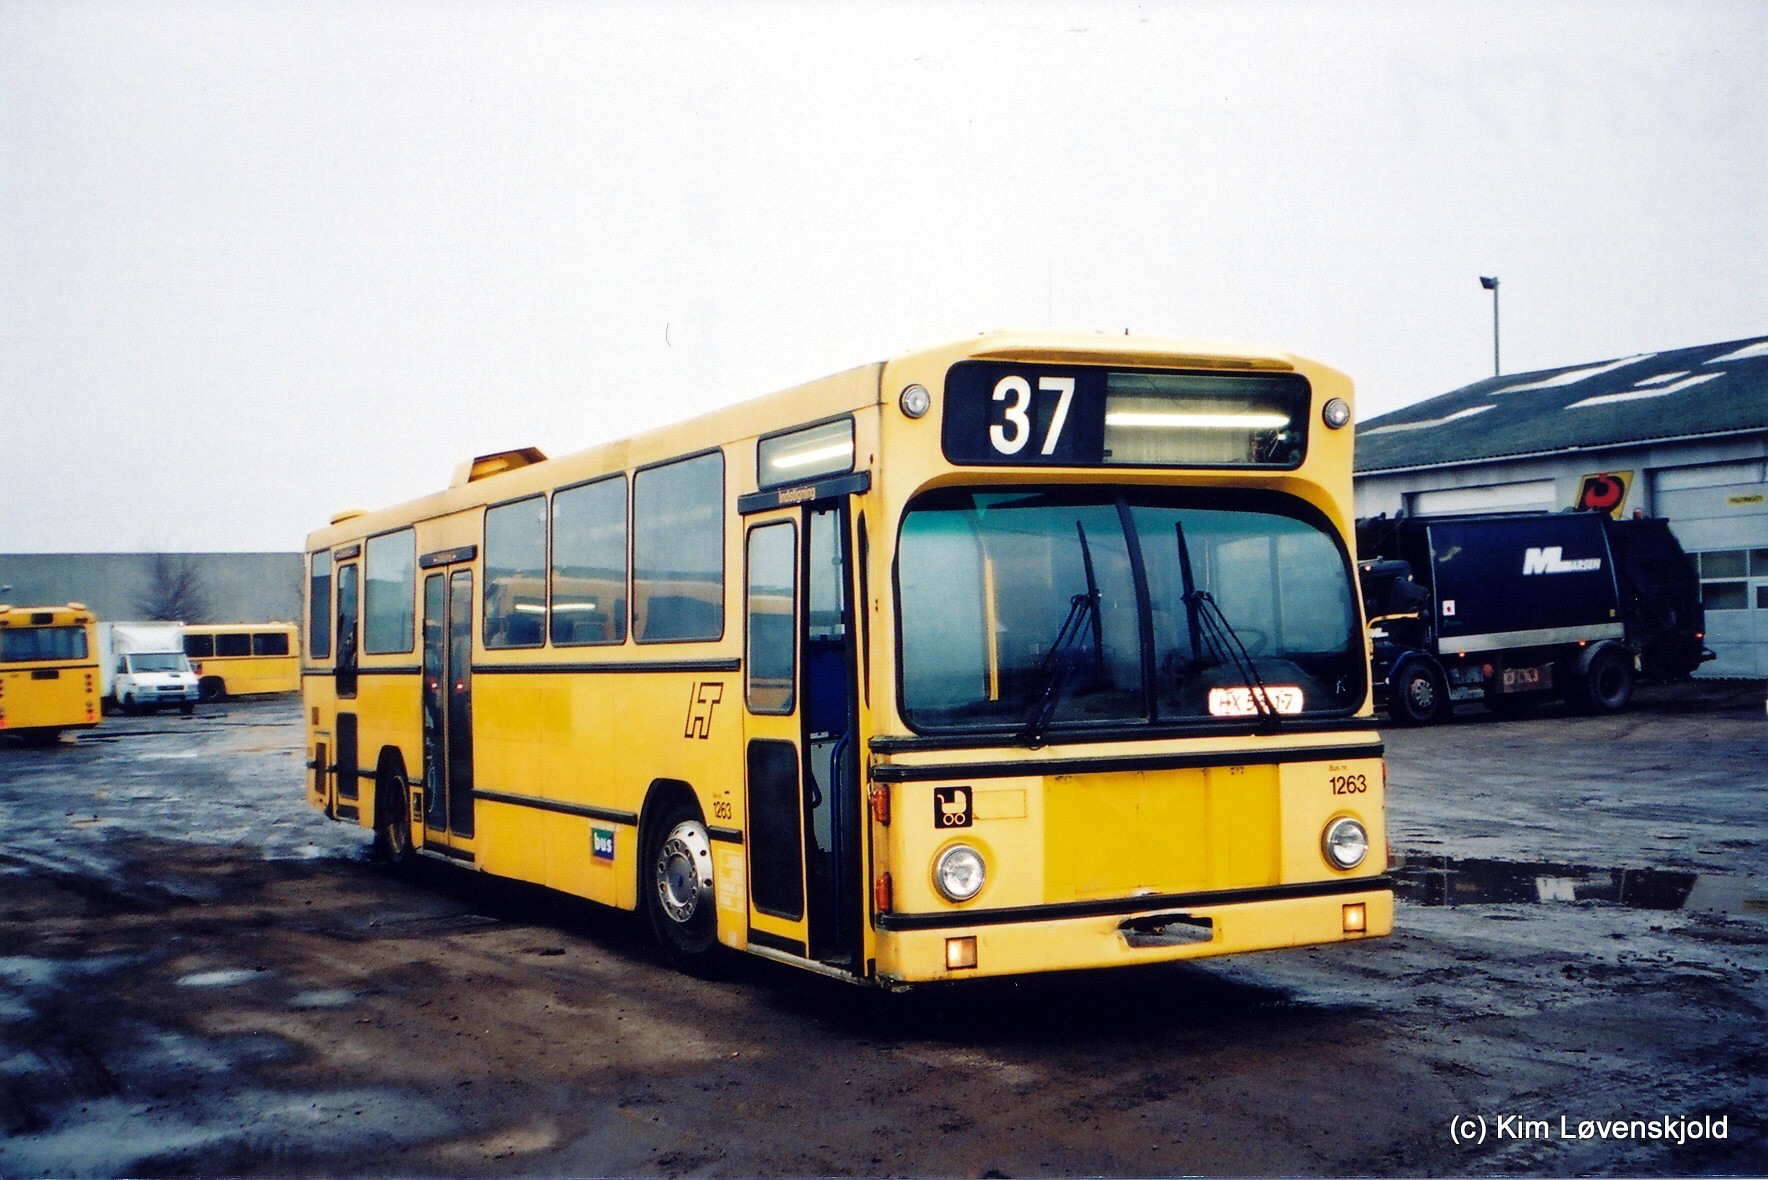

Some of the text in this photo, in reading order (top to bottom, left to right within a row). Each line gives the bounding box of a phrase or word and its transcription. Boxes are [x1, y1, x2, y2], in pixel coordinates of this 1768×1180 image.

[989, 375, 1075, 455] 37
[1329, 774, 1367, 795] 1263
[713, 801, 732, 820] 1263
[593, 831, 612, 853] bus
